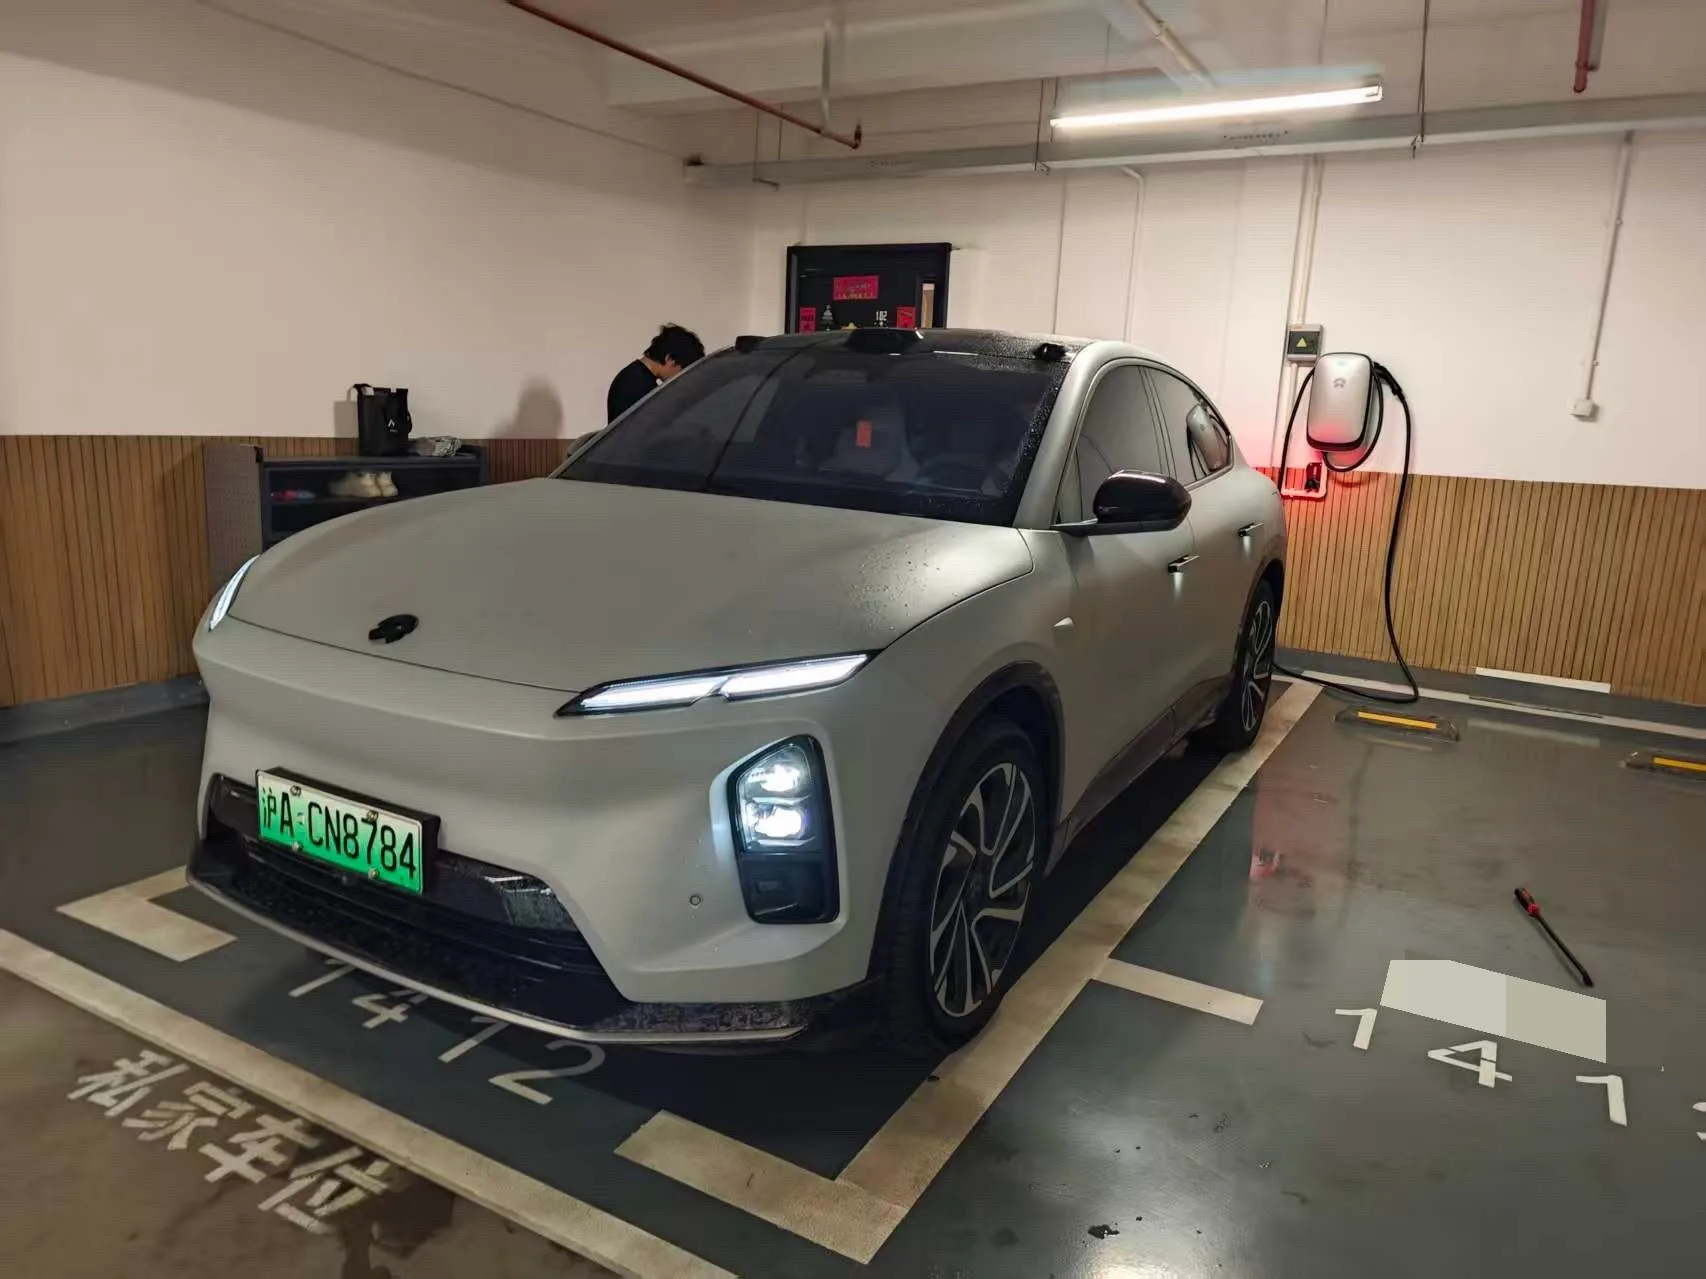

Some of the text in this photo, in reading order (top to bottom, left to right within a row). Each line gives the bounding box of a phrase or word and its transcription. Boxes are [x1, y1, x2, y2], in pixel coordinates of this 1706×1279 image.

[66, 1049, 393, 1235] 私家车位
[1335, 1007, 1706, 1141] 141
